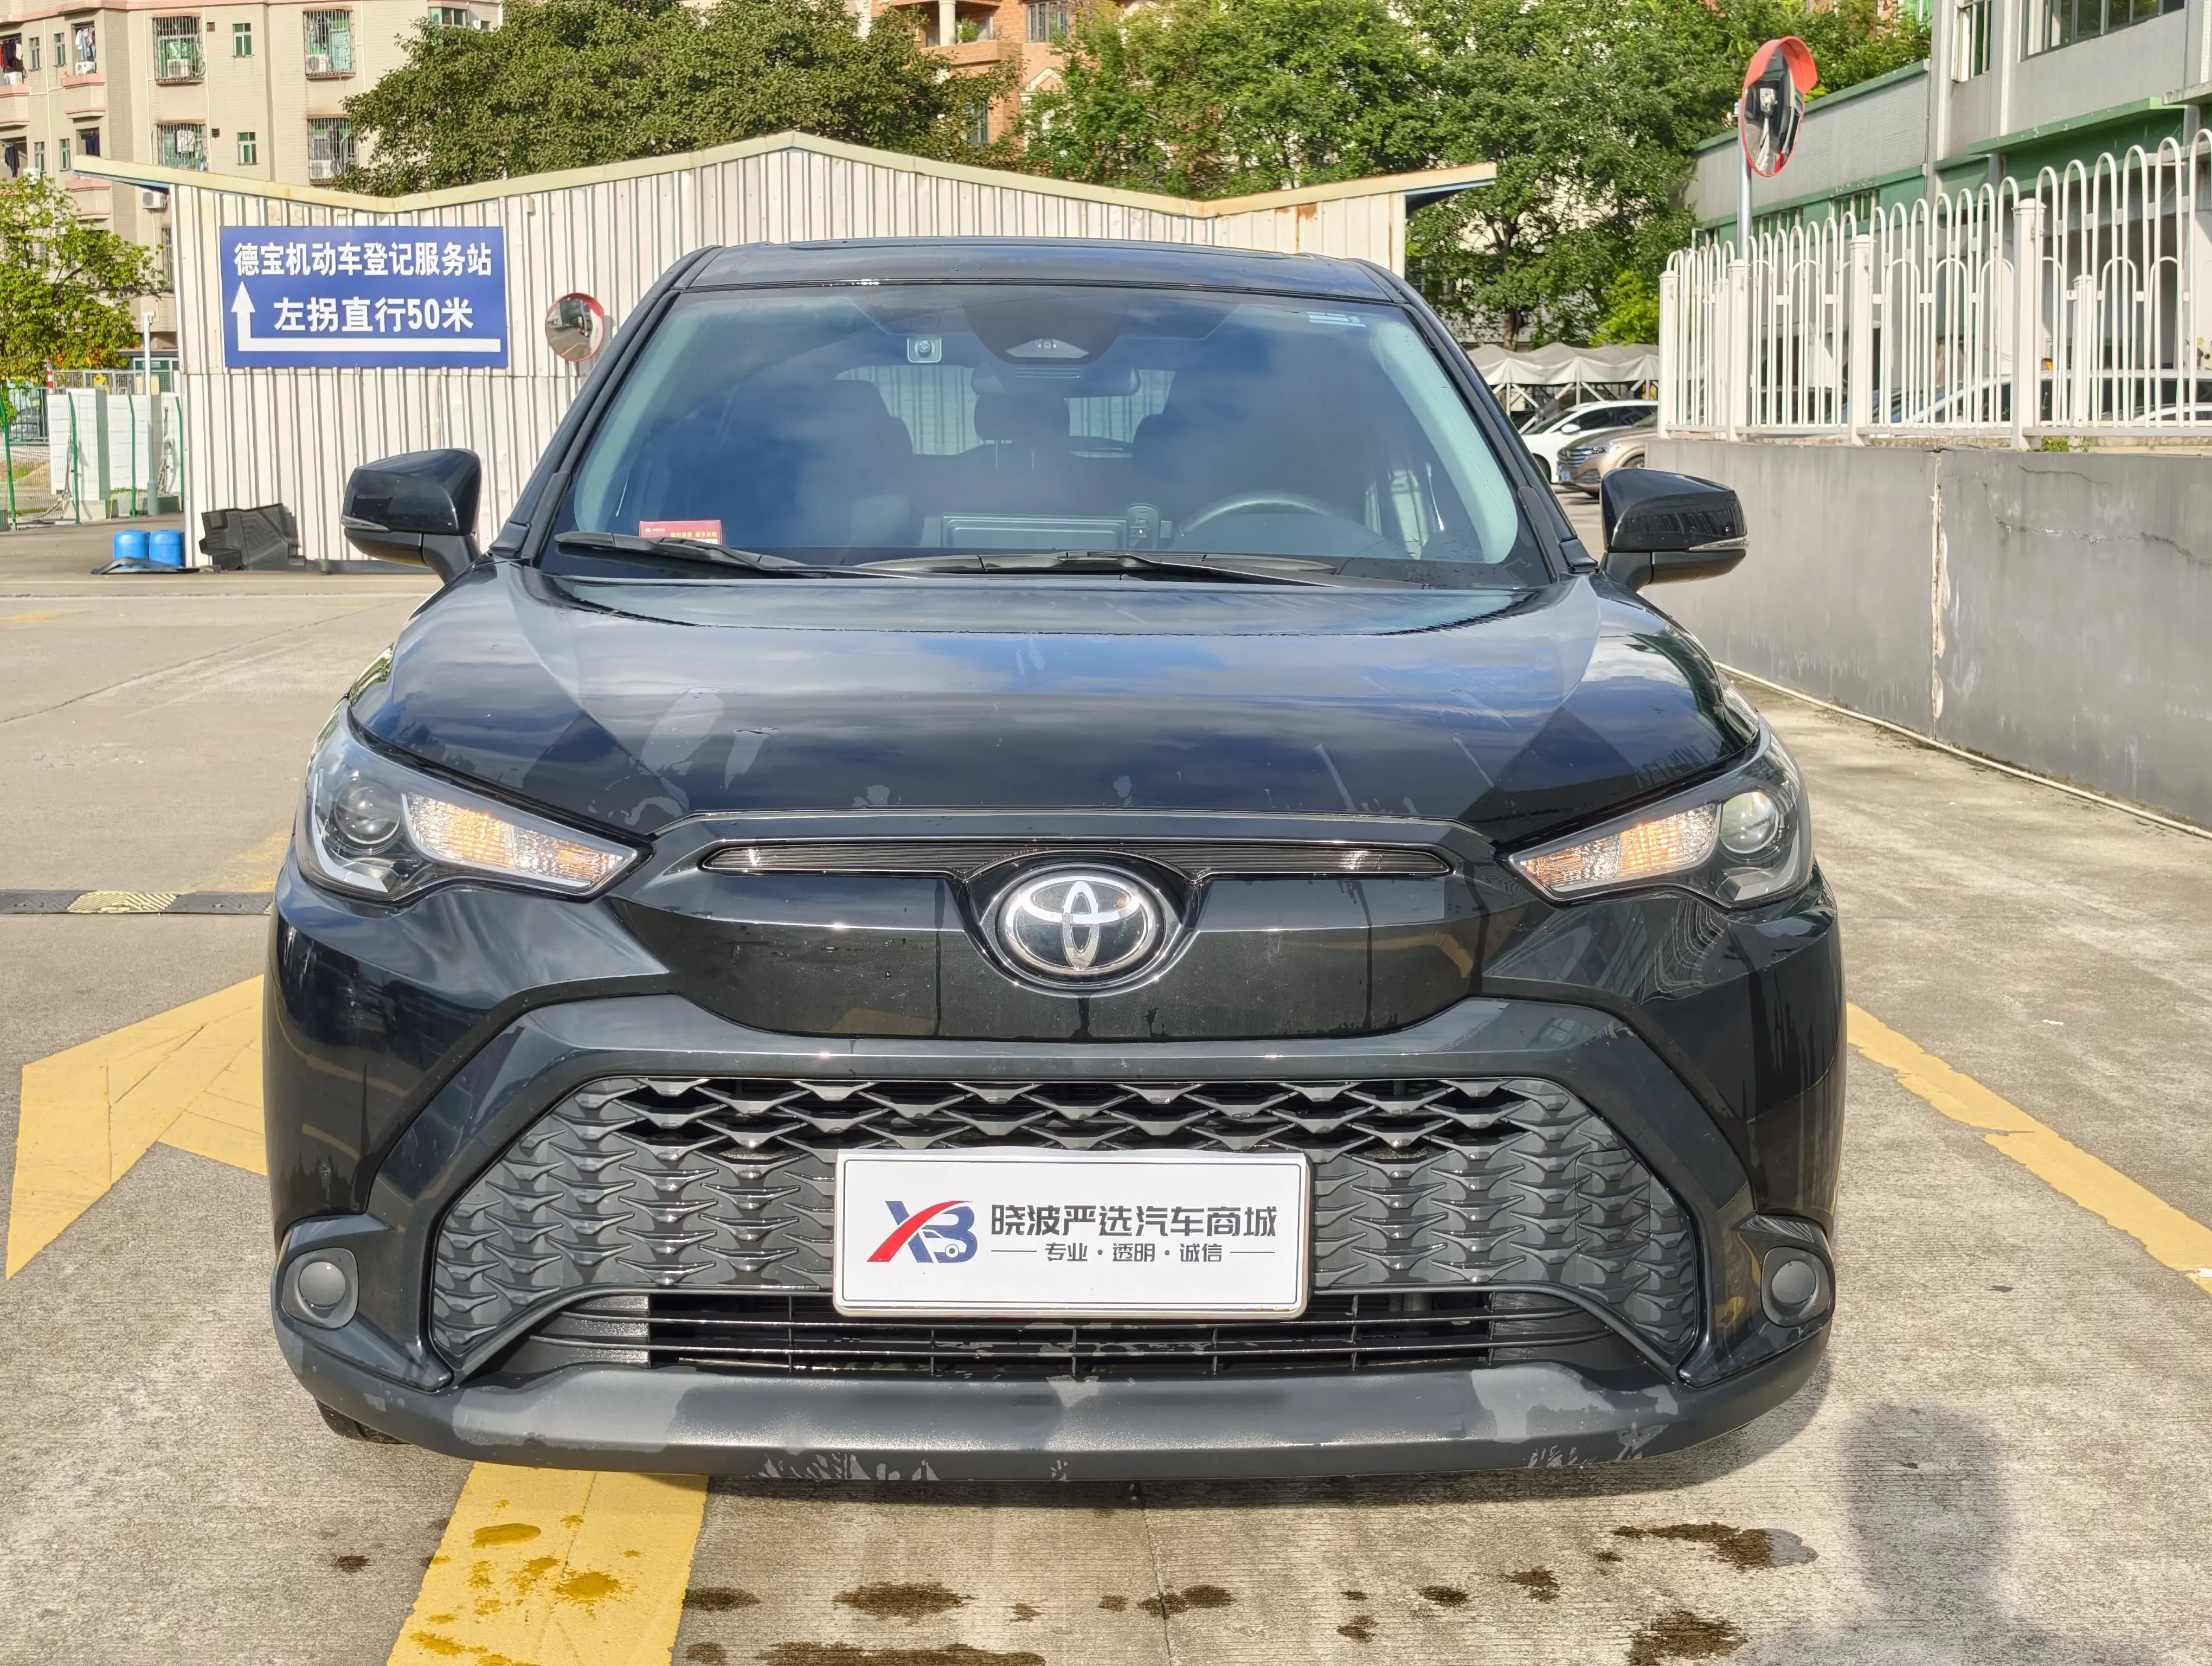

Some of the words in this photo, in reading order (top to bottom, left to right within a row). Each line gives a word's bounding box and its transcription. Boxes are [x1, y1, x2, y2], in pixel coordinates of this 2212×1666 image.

[234, 241, 491, 276] 德宝机动车登记服务站
[274, 296, 473, 332] 左拐直行50米
[991, 1205, 1276, 1237] 晓波严选汽车商城
